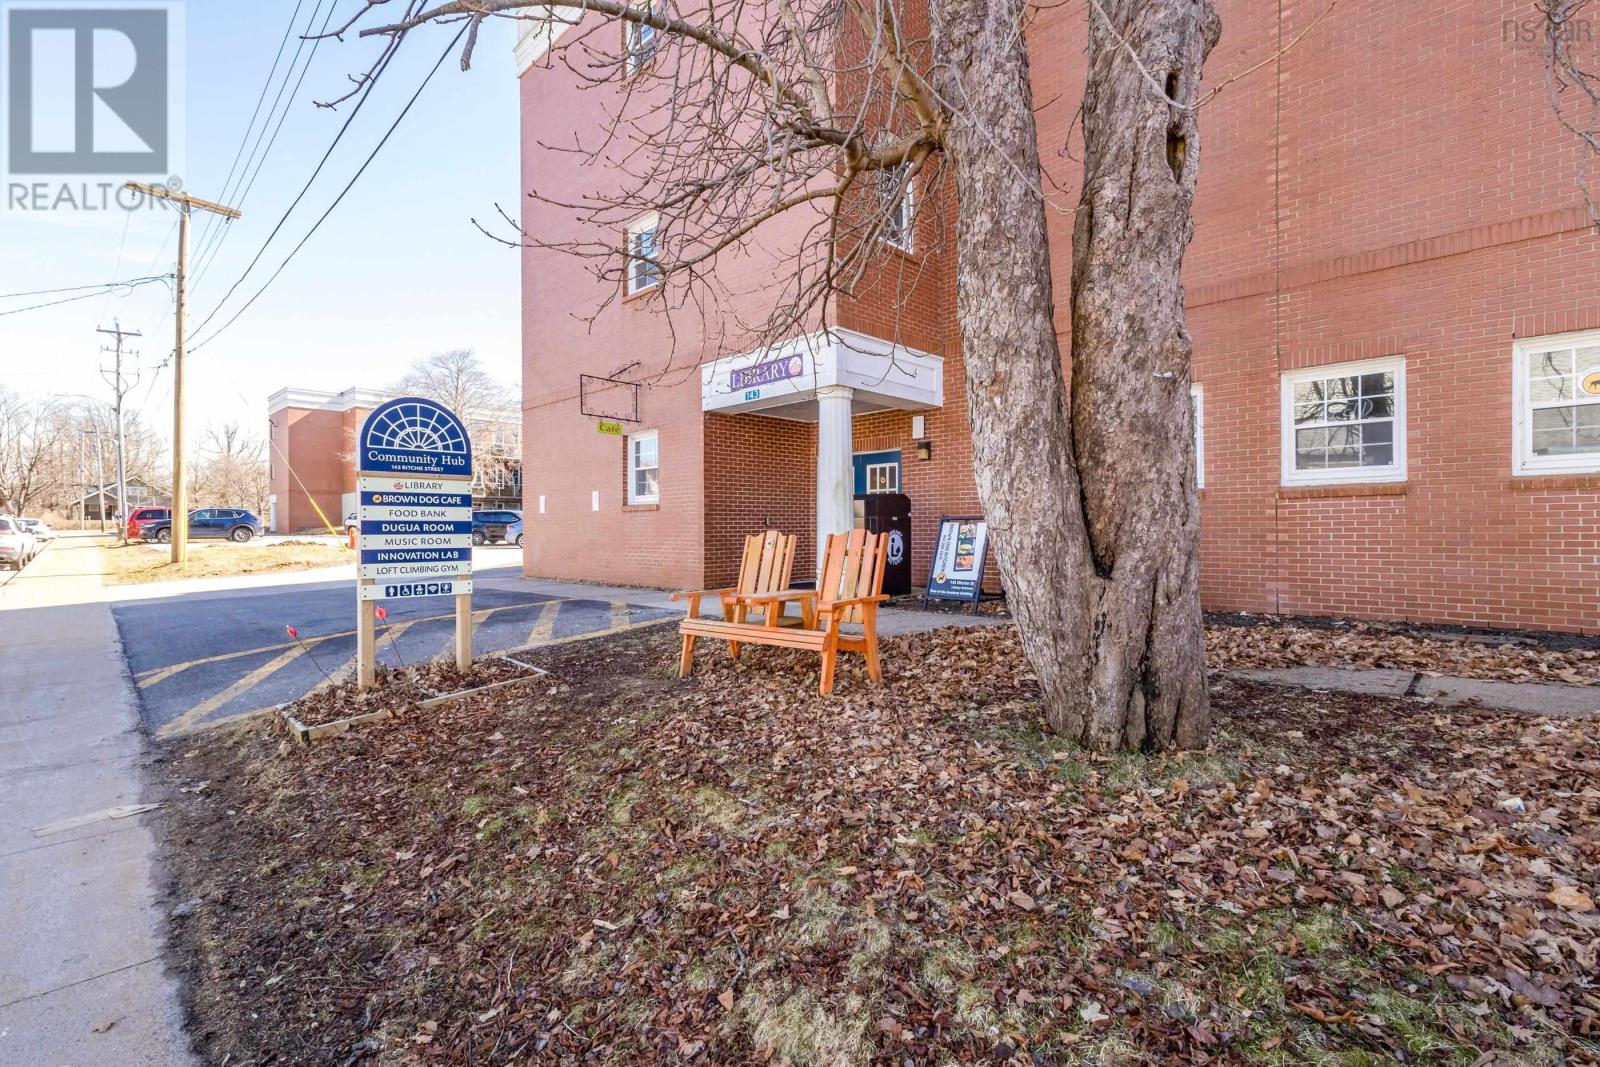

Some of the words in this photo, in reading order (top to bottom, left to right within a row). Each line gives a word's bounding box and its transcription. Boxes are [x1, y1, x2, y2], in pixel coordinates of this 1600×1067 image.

[732, 361, 788, 388] LIBRARY
[745, 390, 759, 400] 143
[368, 450, 438, 467] Community
[441, 454, 466, 467] Hub
[404, 481, 443, 490] LIBRARY
[383, 494, 418, 504] BROWN
[419, 495, 439, 504] DOG
[441, 496, 462, 505] CAFE
[388, 509, 418, 518] FOOD
[421, 509, 447, 518] BANK
[382, 523, 420, 532] DUGUA
[423, 523, 454, 532] ROOM
[384, 537, 418, 546] MUSIC
[420, 537, 452, 546] ROOM
[377, 551, 439, 562] INNOVATION
[441, 551, 459, 560] LAB
[376, 566, 398, 575] LOFT
[400, 564, 439, 574] CLIMBING
[441, 564, 459, 573] GYM
